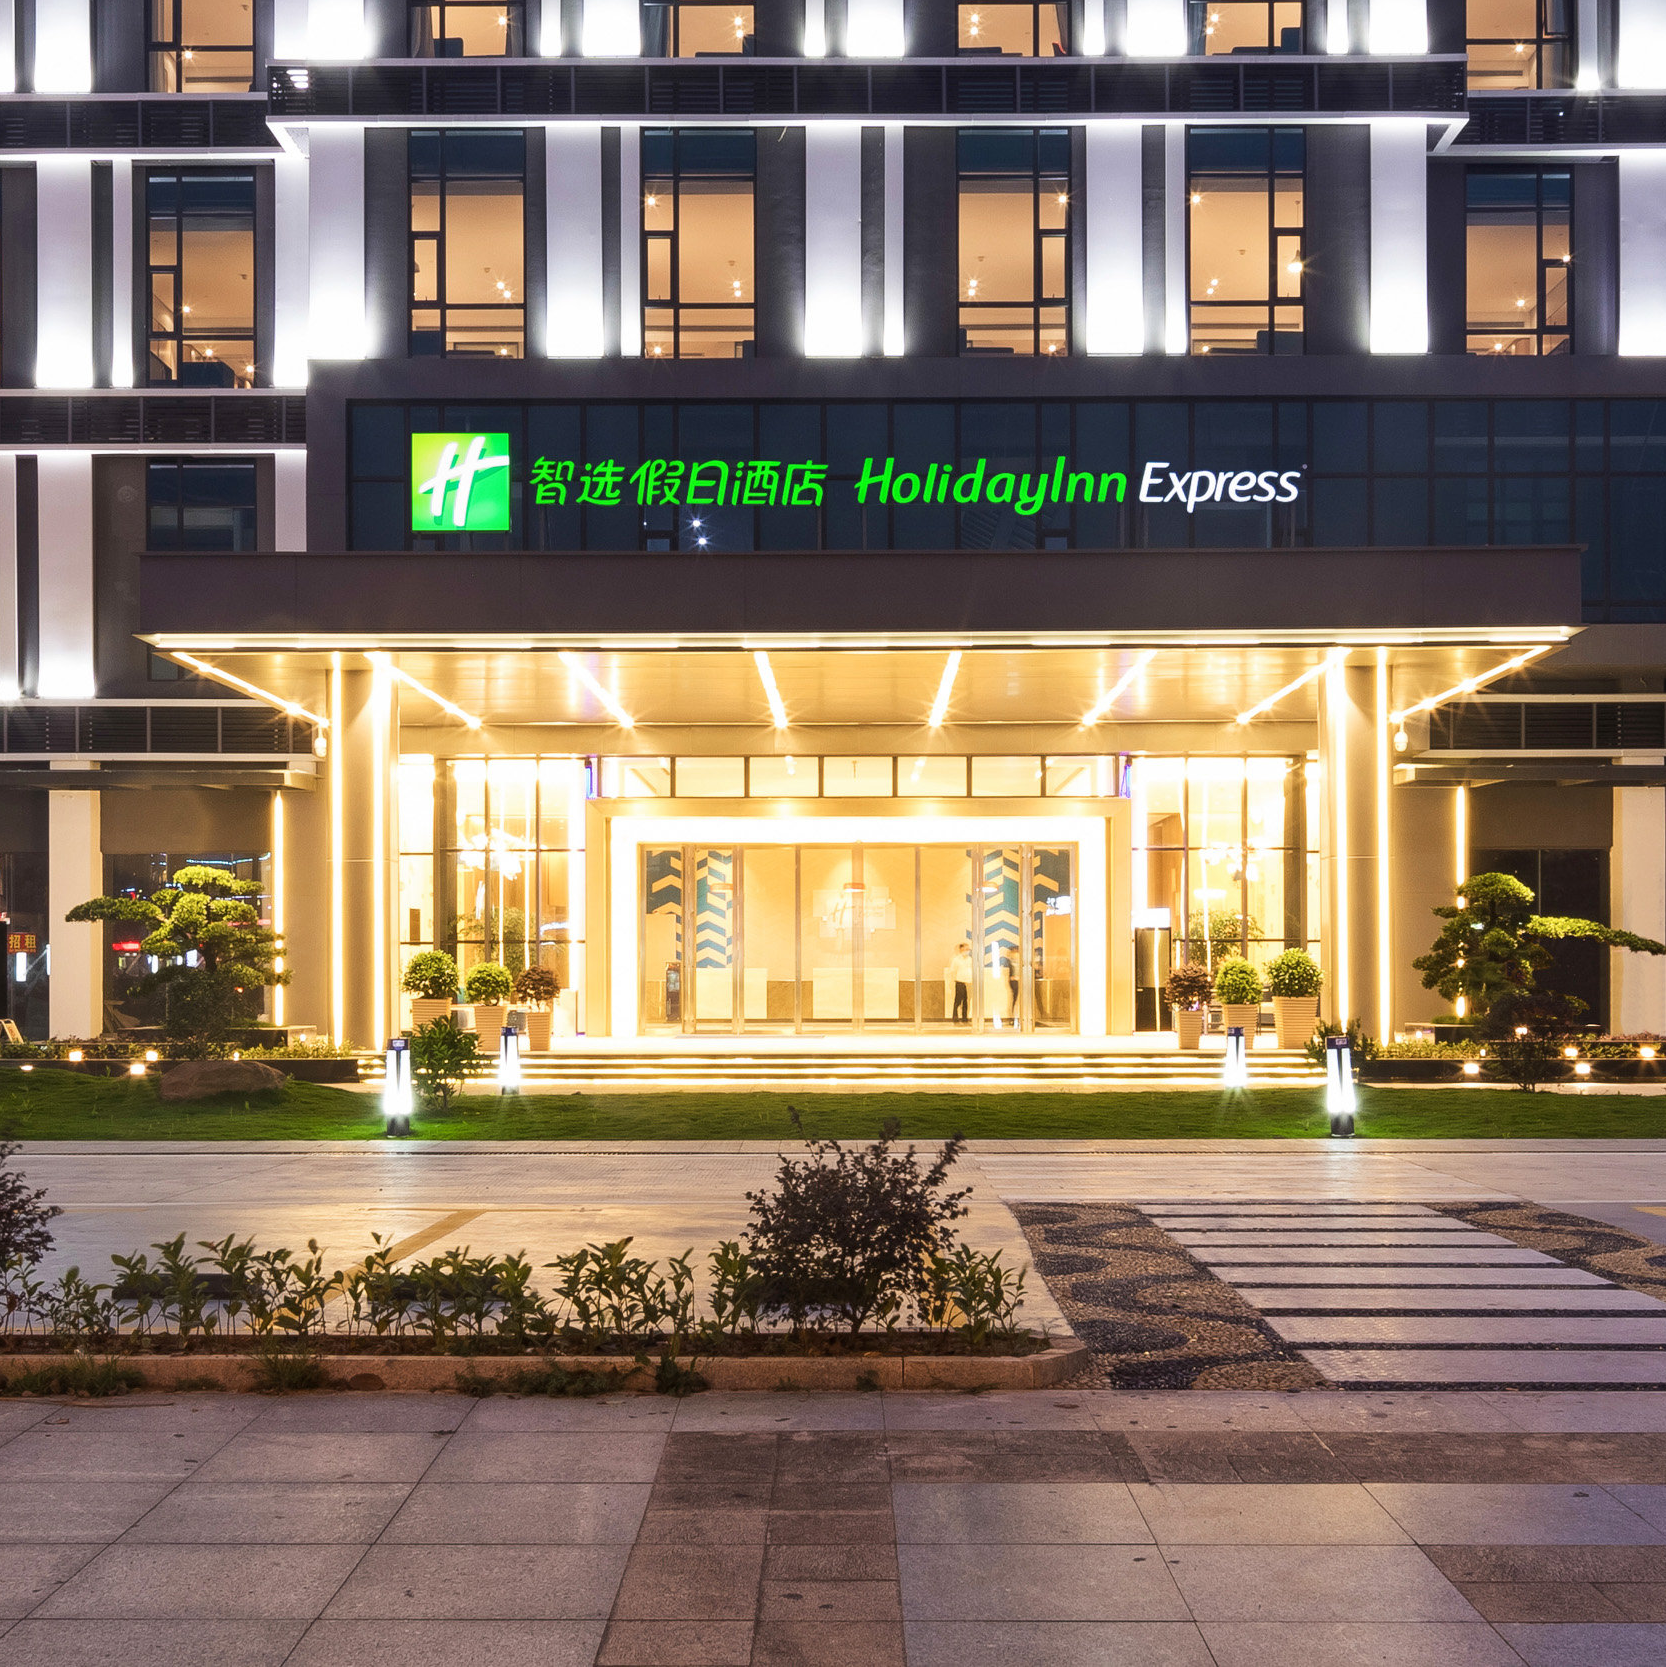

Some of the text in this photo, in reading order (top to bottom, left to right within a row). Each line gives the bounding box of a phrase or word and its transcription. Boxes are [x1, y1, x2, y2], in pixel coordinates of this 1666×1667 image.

[529, 456, 829, 507] 智选假日酒店
[1138, 462, 1301, 514] Express
[8, 934, 37, 949] 招租
